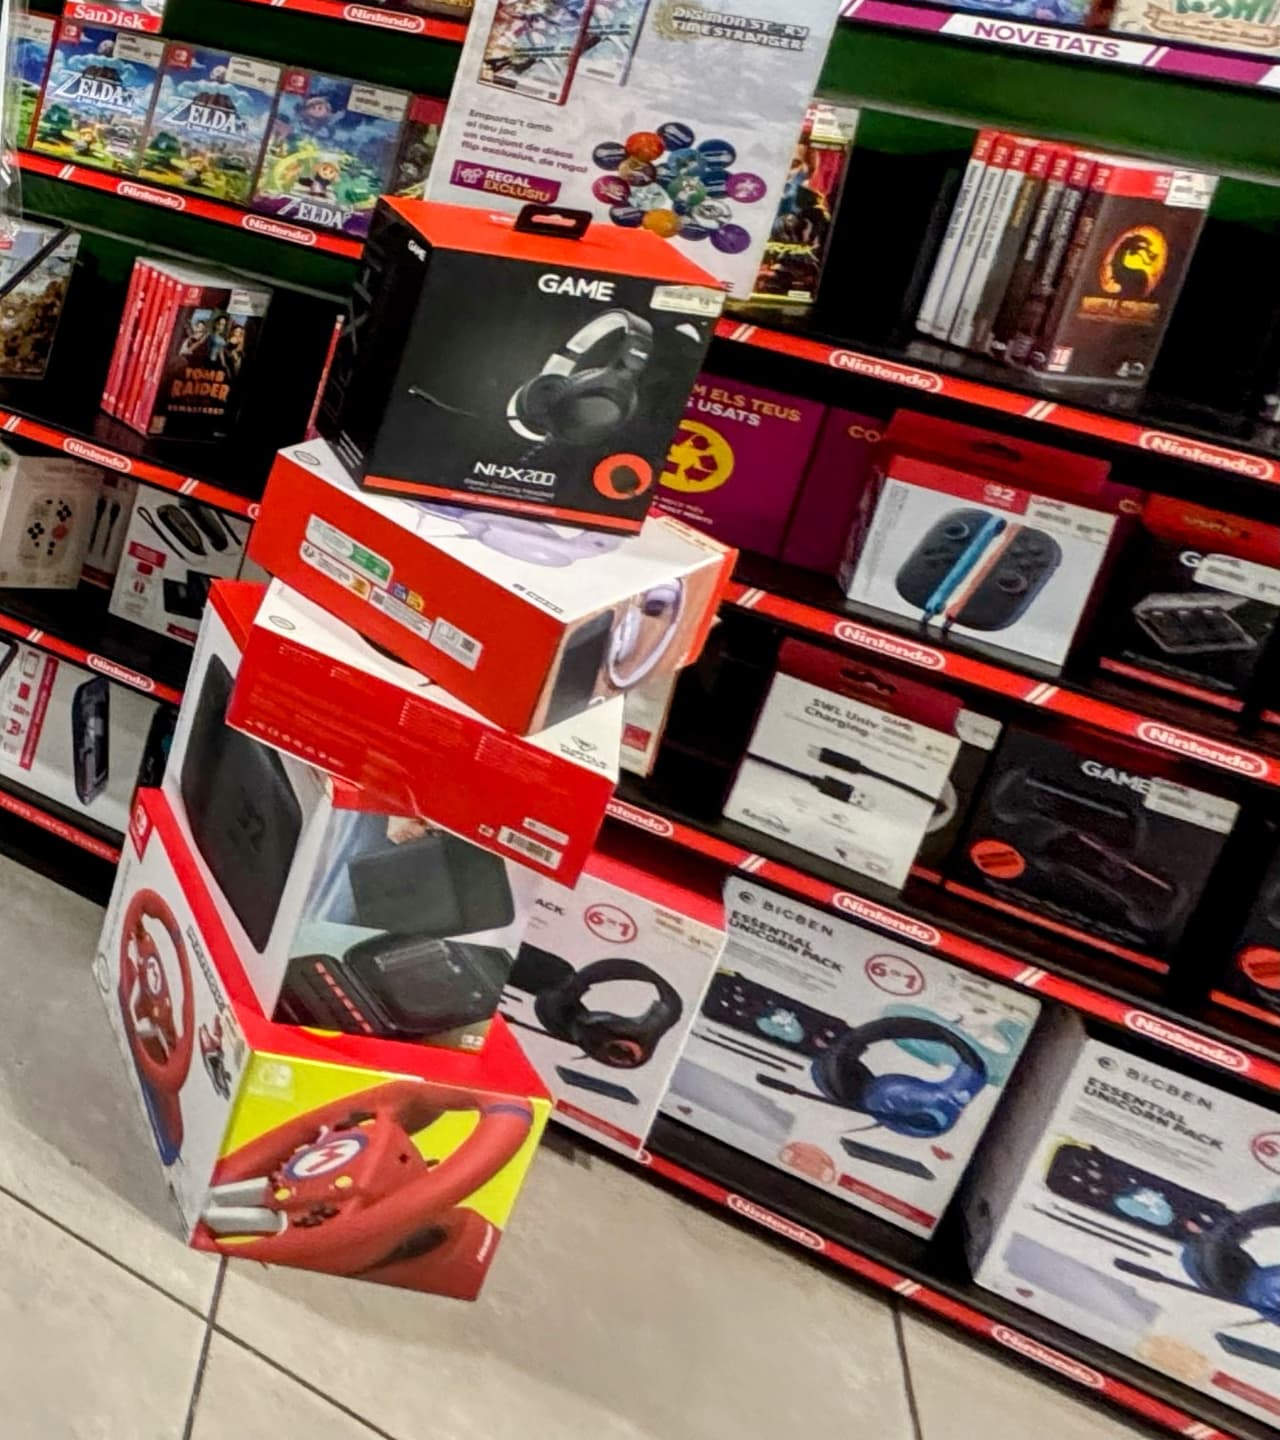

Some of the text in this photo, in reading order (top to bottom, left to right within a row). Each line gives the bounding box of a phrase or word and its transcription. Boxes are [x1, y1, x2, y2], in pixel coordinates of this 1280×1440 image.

[74, 4, 145, 30] SanDisk
[352, 8, 421, 30] Nintendo
[974, 22, 1121, 58] NOVETATS
[55, 72, 125, 103] ZELDA
[161, 96, 241, 134] ZELDA
[469, 109, 553, 132] Emporta't amb
[480, 135, 573, 159] conjunt de discs
[483, 181, 551, 201] EXCLUSIU
[486, 170, 531, 187] REGAL
[123, 184, 181, 209] Nintendo
[277, 196, 353, 228] ZELDA
[248, 216, 313, 244] Nintendo
[407, 240, 427, 261] GAME
[539, 273, 615, 301] GAME
[186, 366, 225, 384] TOMB
[839, 353, 935, 390] Nintendo
[170, 379, 230, 403] RAIDER
[711, 389, 802, 423] ELS TEUS
[698, 399, 762, 428] USATS
[69, 440, 128, 470] Nintendo
[1149, 435, 1262, 475] Nintendo
[473, 460, 556, 486] NHX200
[843, 624, 939, 667] Nintendo
[804, 706, 870, 737] Charging
[1148, 727, 1261, 773] Nintendo
[1081, 761, 1153, 795] GAME
[732, 910, 813, 951] ESSENTIAL
[843, 897, 930, 940] Nintendo
[729, 919, 799, 953] UNICORN
[802, 947, 844, 973] PACK
[1135, 1013, 1246, 1068] Nintendo
[1087, 1077, 1188, 1126] ESSENTIAL
[1084, 1085, 1170, 1127] UNICORN
[1173, 1123, 1224, 1152] PACK
